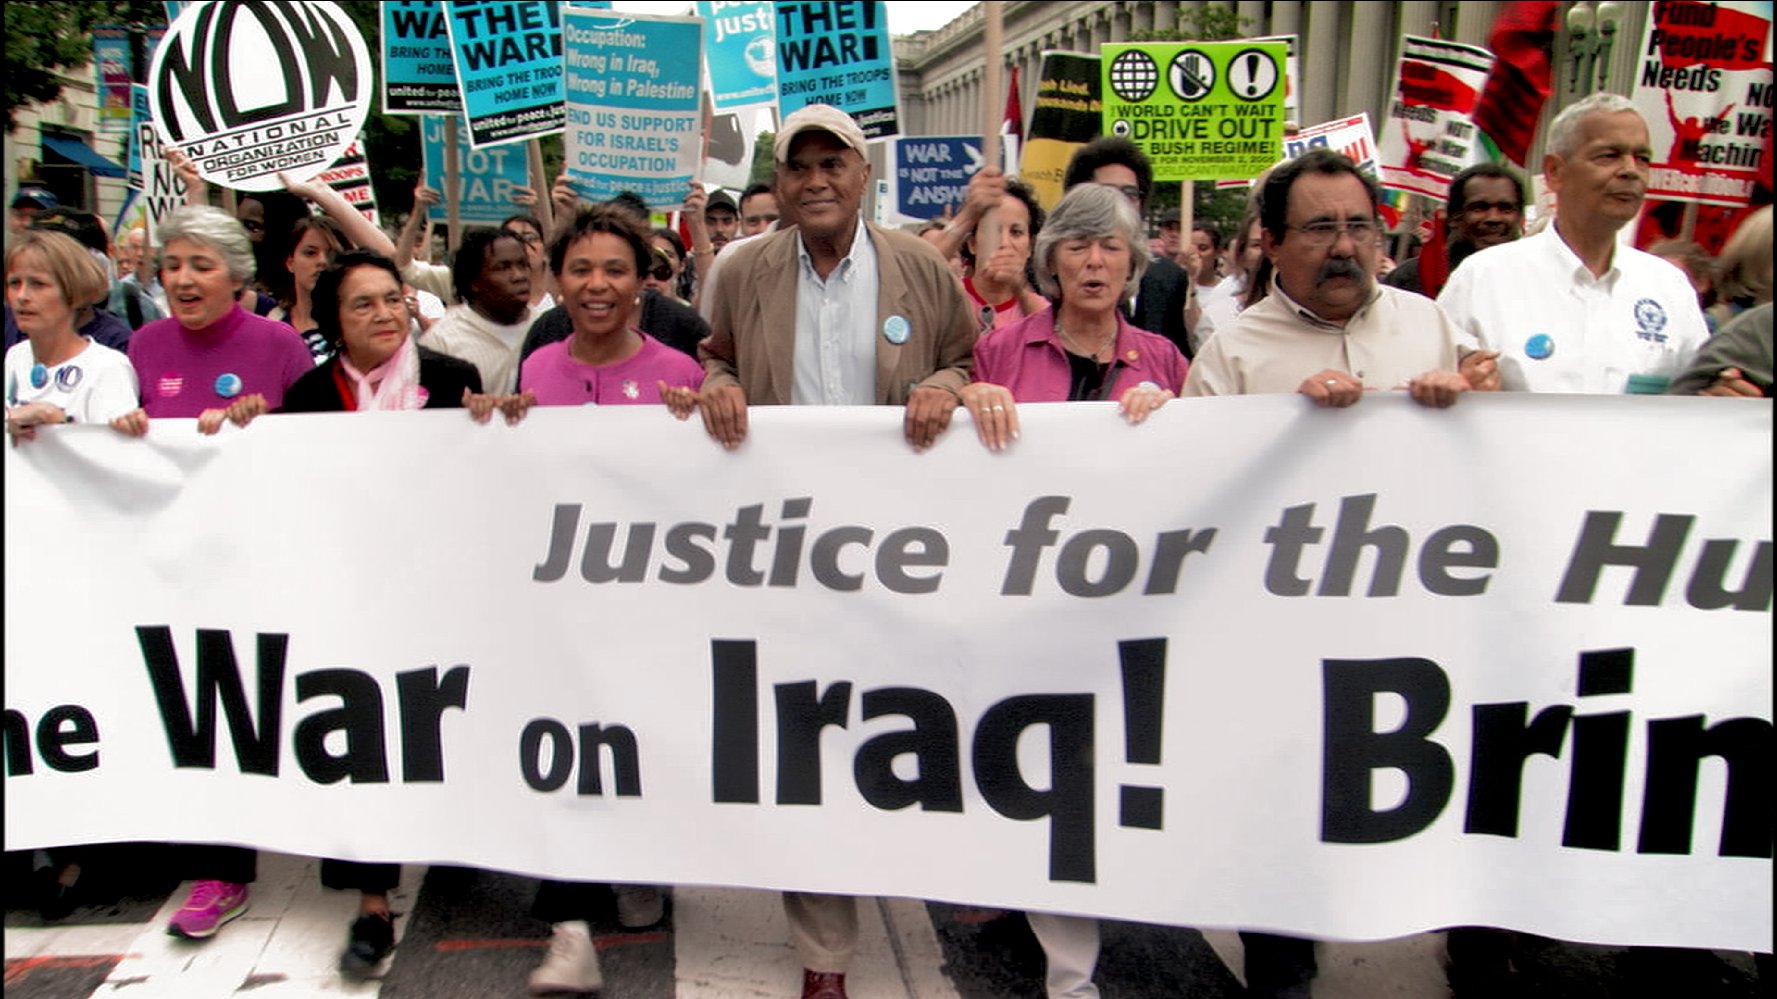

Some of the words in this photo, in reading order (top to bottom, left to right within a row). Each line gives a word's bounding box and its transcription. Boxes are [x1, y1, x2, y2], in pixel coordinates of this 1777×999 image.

[455, 2, 544, 39] THE
[778, 1, 857, 37] THE
[566, 23, 646, 49] Occupation:
[1648, 30, 1759, 62] People's
[390, 46, 430, 58] BRING
[567, 48, 606, 74] Wrong
[610, 53, 624, 71] in
[627, 54, 660, 78] Iraq,
[157, 1, 358, 140] NOW
[417, 63, 454, 75] HOME
[467, 76, 504, 93] BRING
[506, 71, 531, 84] THE
[781, 79, 816, 96] BRING
[821, 74, 846, 90] THE
[847, 68, 890, 84] TROOPS
[1641, 61, 1721, 92] Needs
[494, 87, 530, 104] HOME
[531, 83, 557, 98] NOW
[567, 72, 606, 98] Wrong
[609, 77, 623, 95] in
[627, 78, 694, 99] Palestine
[567, 107, 591, 125] END
[596, 113, 617, 128] US
[621, 115, 695, 132] SUPPORT
[1117, 105, 1174, 117] WORLD
[1181, 104, 1228, 117] CAN'T
[1235, 104, 1276, 116] WAIT
[187, 113, 350, 158] NATIONAL
[577, 131, 605, 147] FOR
[610, 134, 679, 152] ISRAEL'S
[1134, 119, 1208, 140] DRIVE
[1219, 118, 1276, 139] OUT
[203, 132, 340, 171] ORGANIZATION
[904, 143, 953, 163] WAR
[1152, 142, 1195, 155] BUSH
[1201, 141, 1275, 154] REGIME!
[227, 164, 258, 179] FOR
[261, 150, 325, 170] WOMEN
[578, 151, 676, 172] OCCUPATION
[910, 167, 938, 183] NOT
[534, 498, 948, 595] Justice
[1002, 496, 1217, 597] for
[1264, 494, 1499, 597] the
[1555, 511, 1773, 611] Hu
[135, 626, 470, 785] War
[520, 718, 642, 797] on
[711, 637, 1167, 885] Iraq!
[1320, 648, 1773, 860] Brin
